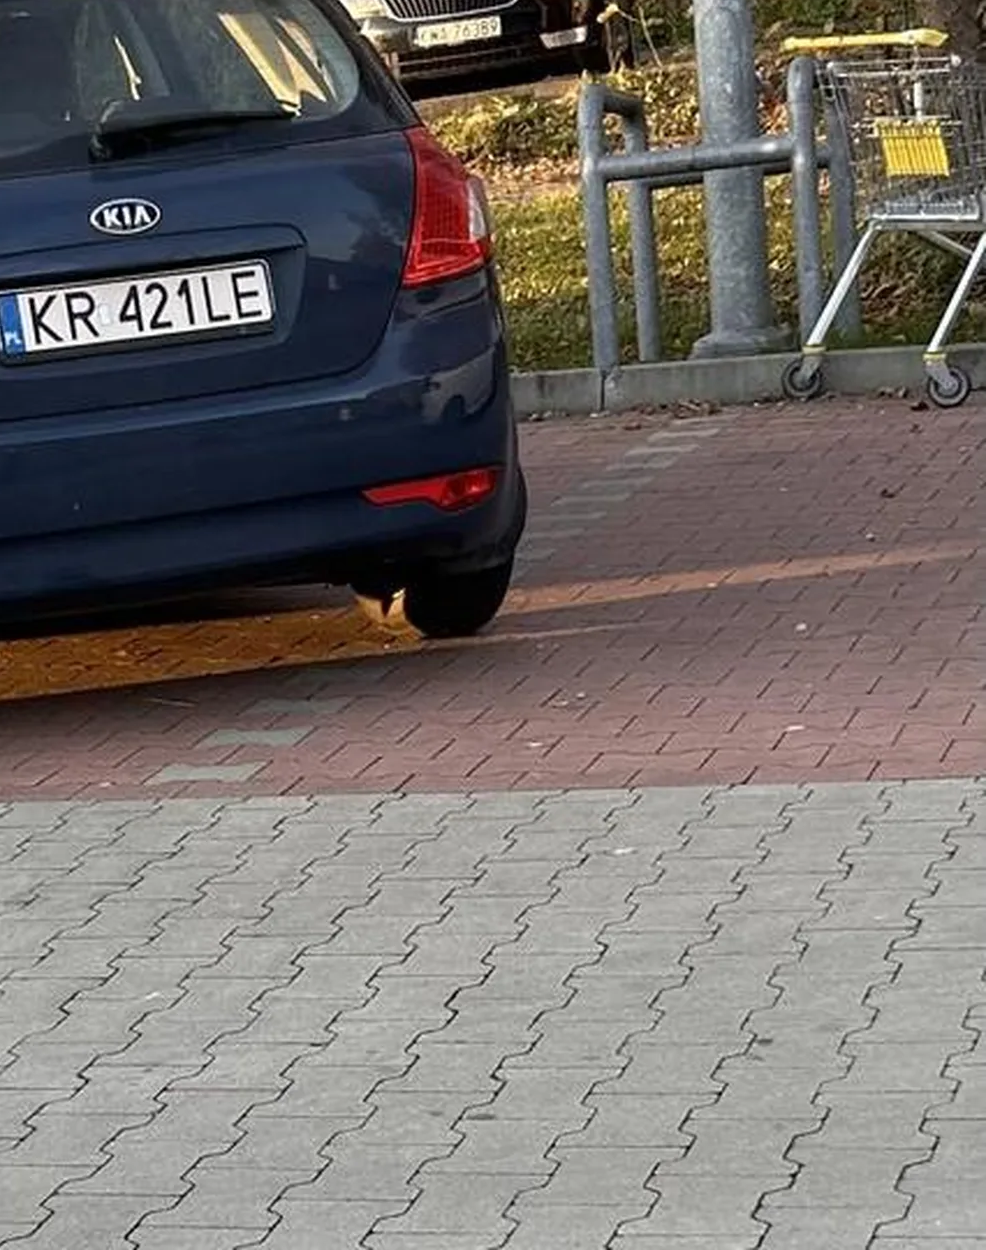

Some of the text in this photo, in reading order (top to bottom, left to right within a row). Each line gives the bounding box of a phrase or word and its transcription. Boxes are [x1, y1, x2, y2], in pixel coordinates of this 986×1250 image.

[102, 205, 152, 228] KIA
[27, 270, 263, 345] KR 421LE
